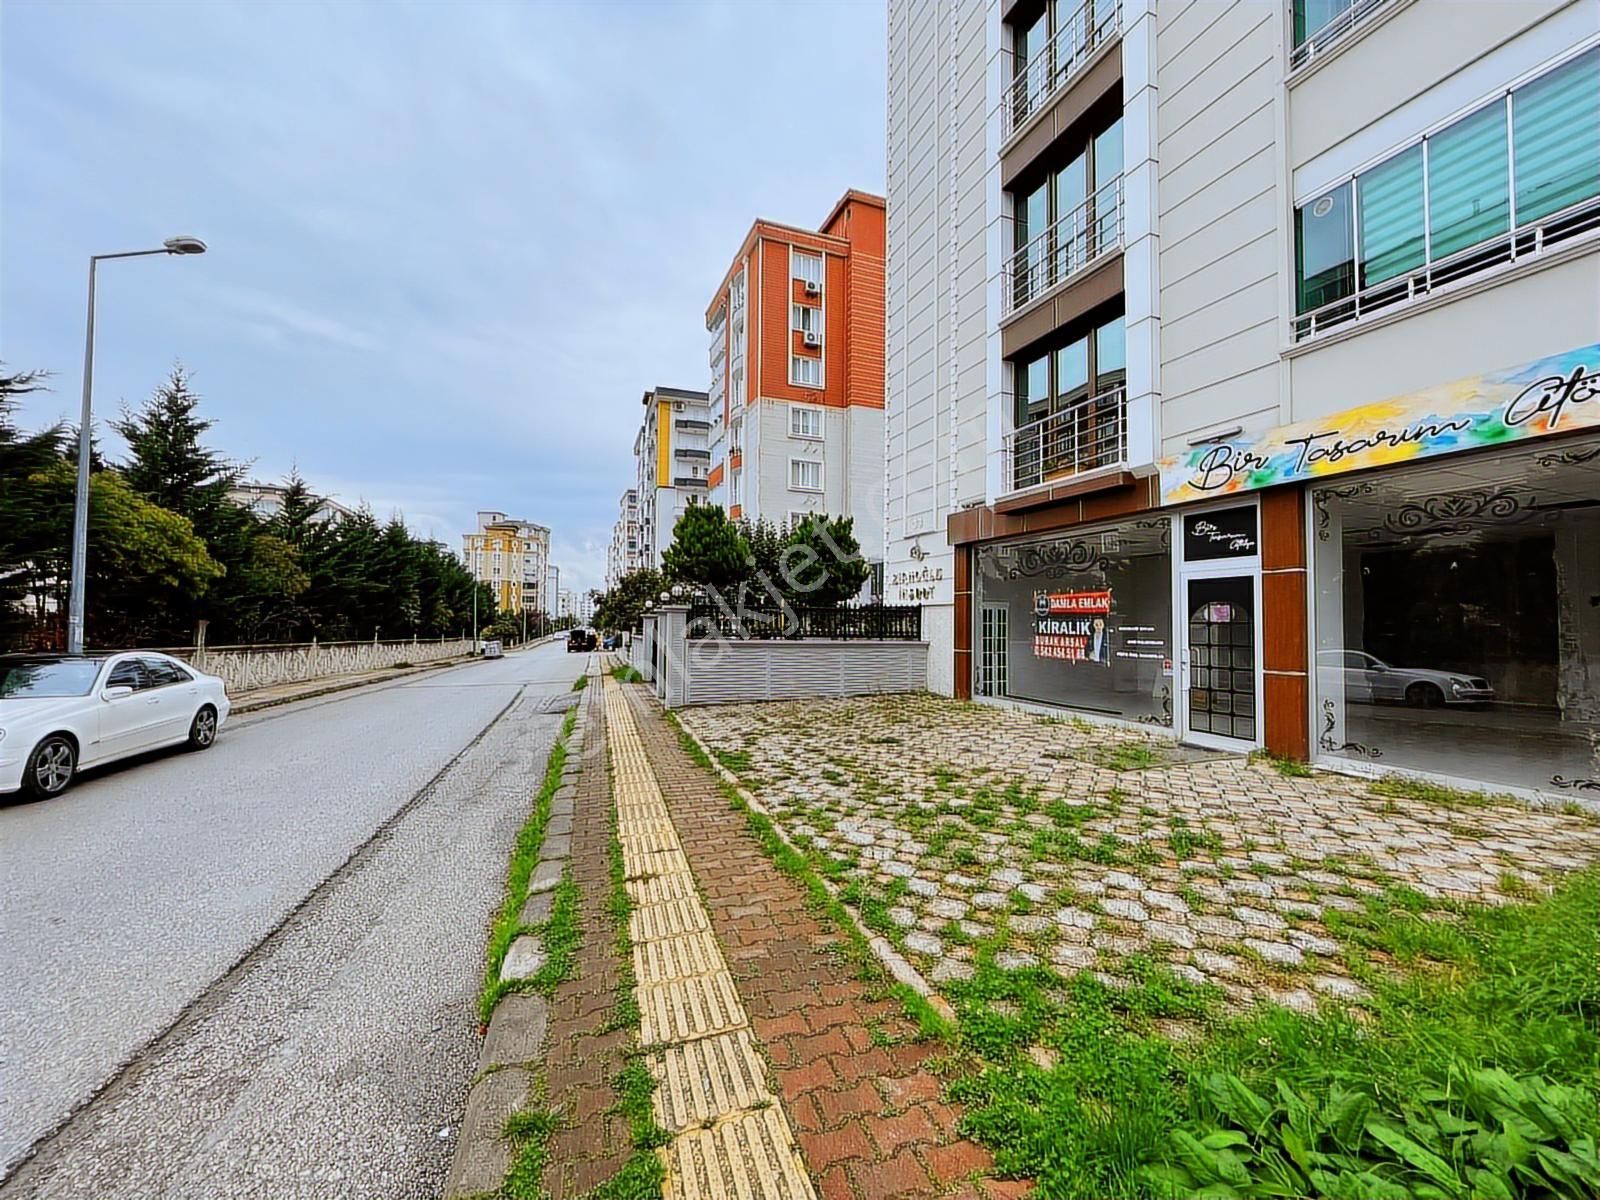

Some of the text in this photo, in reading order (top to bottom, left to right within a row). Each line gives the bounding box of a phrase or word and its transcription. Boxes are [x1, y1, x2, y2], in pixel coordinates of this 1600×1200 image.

[1187, 445, 1269, 491] Bir
[1284, 418, 1471, 473] Tasarım
[1050, 597, 1108, 609] DAMLA EMLAK
[1038, 618, 1091, 635] KİRALIK
